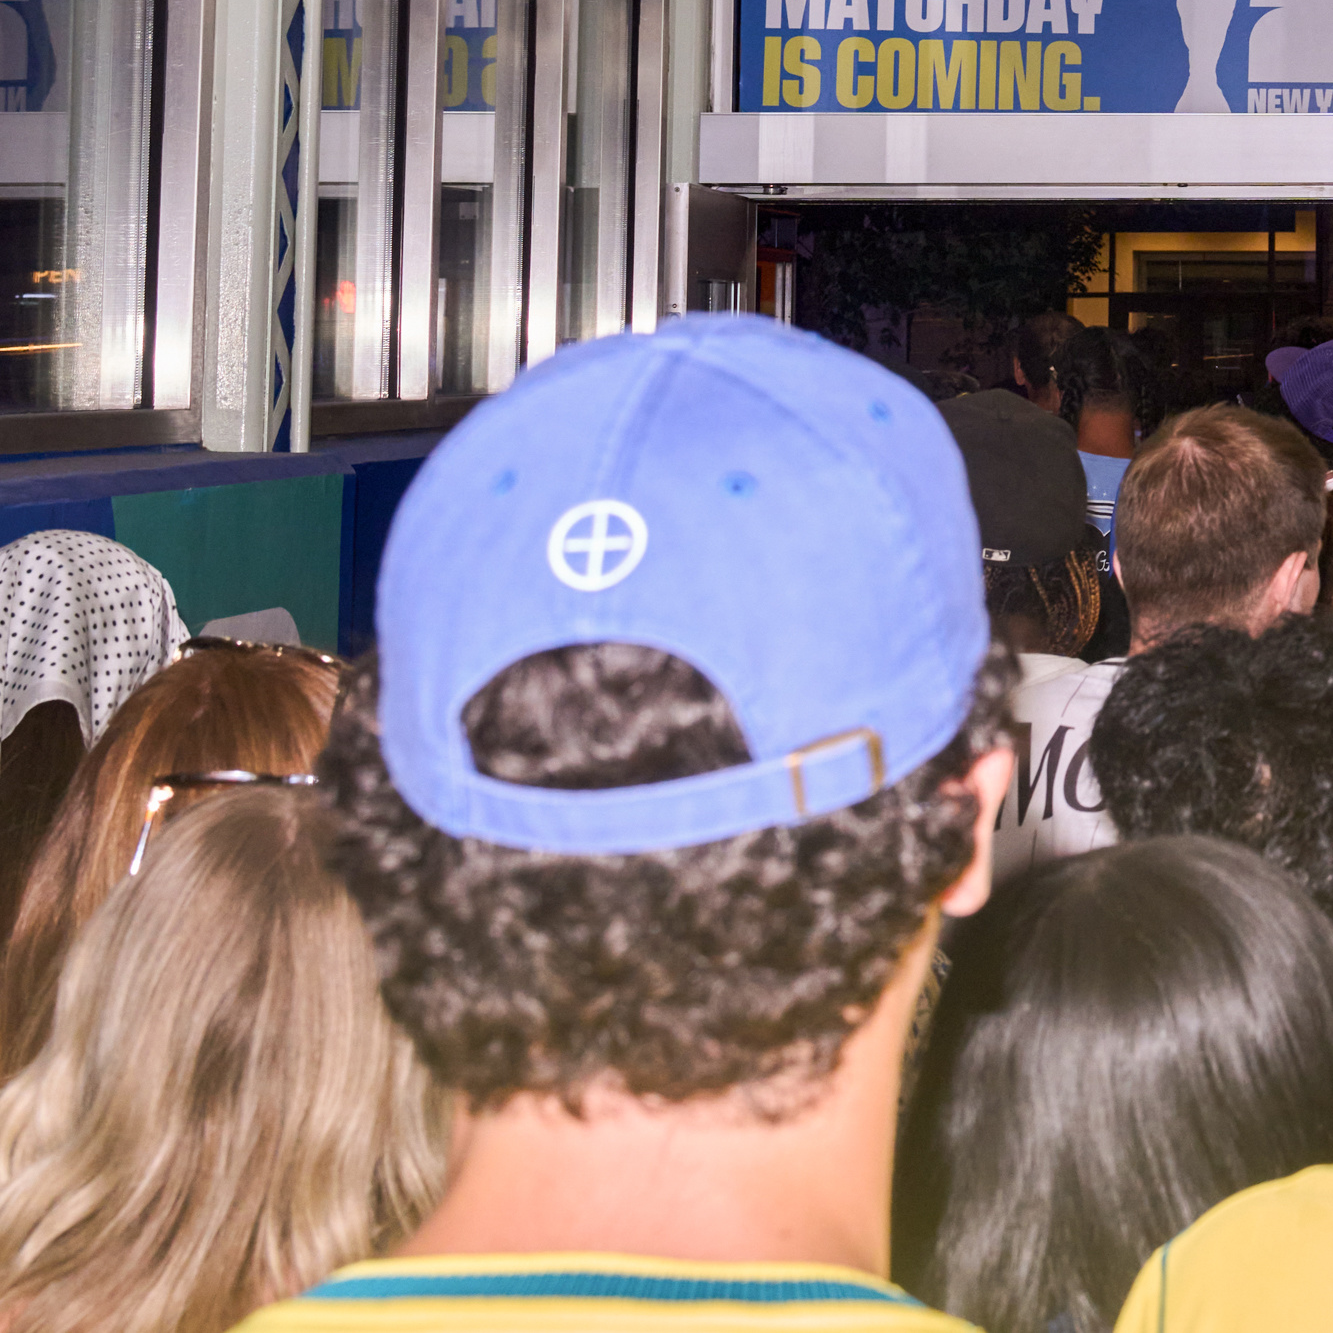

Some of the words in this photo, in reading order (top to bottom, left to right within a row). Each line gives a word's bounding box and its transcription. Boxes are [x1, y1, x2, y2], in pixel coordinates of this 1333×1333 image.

[762, 37, 822, 108] IS
[835, 37, 1101, 111] COMING.
[1247, 88, 1311, 113] NEW
